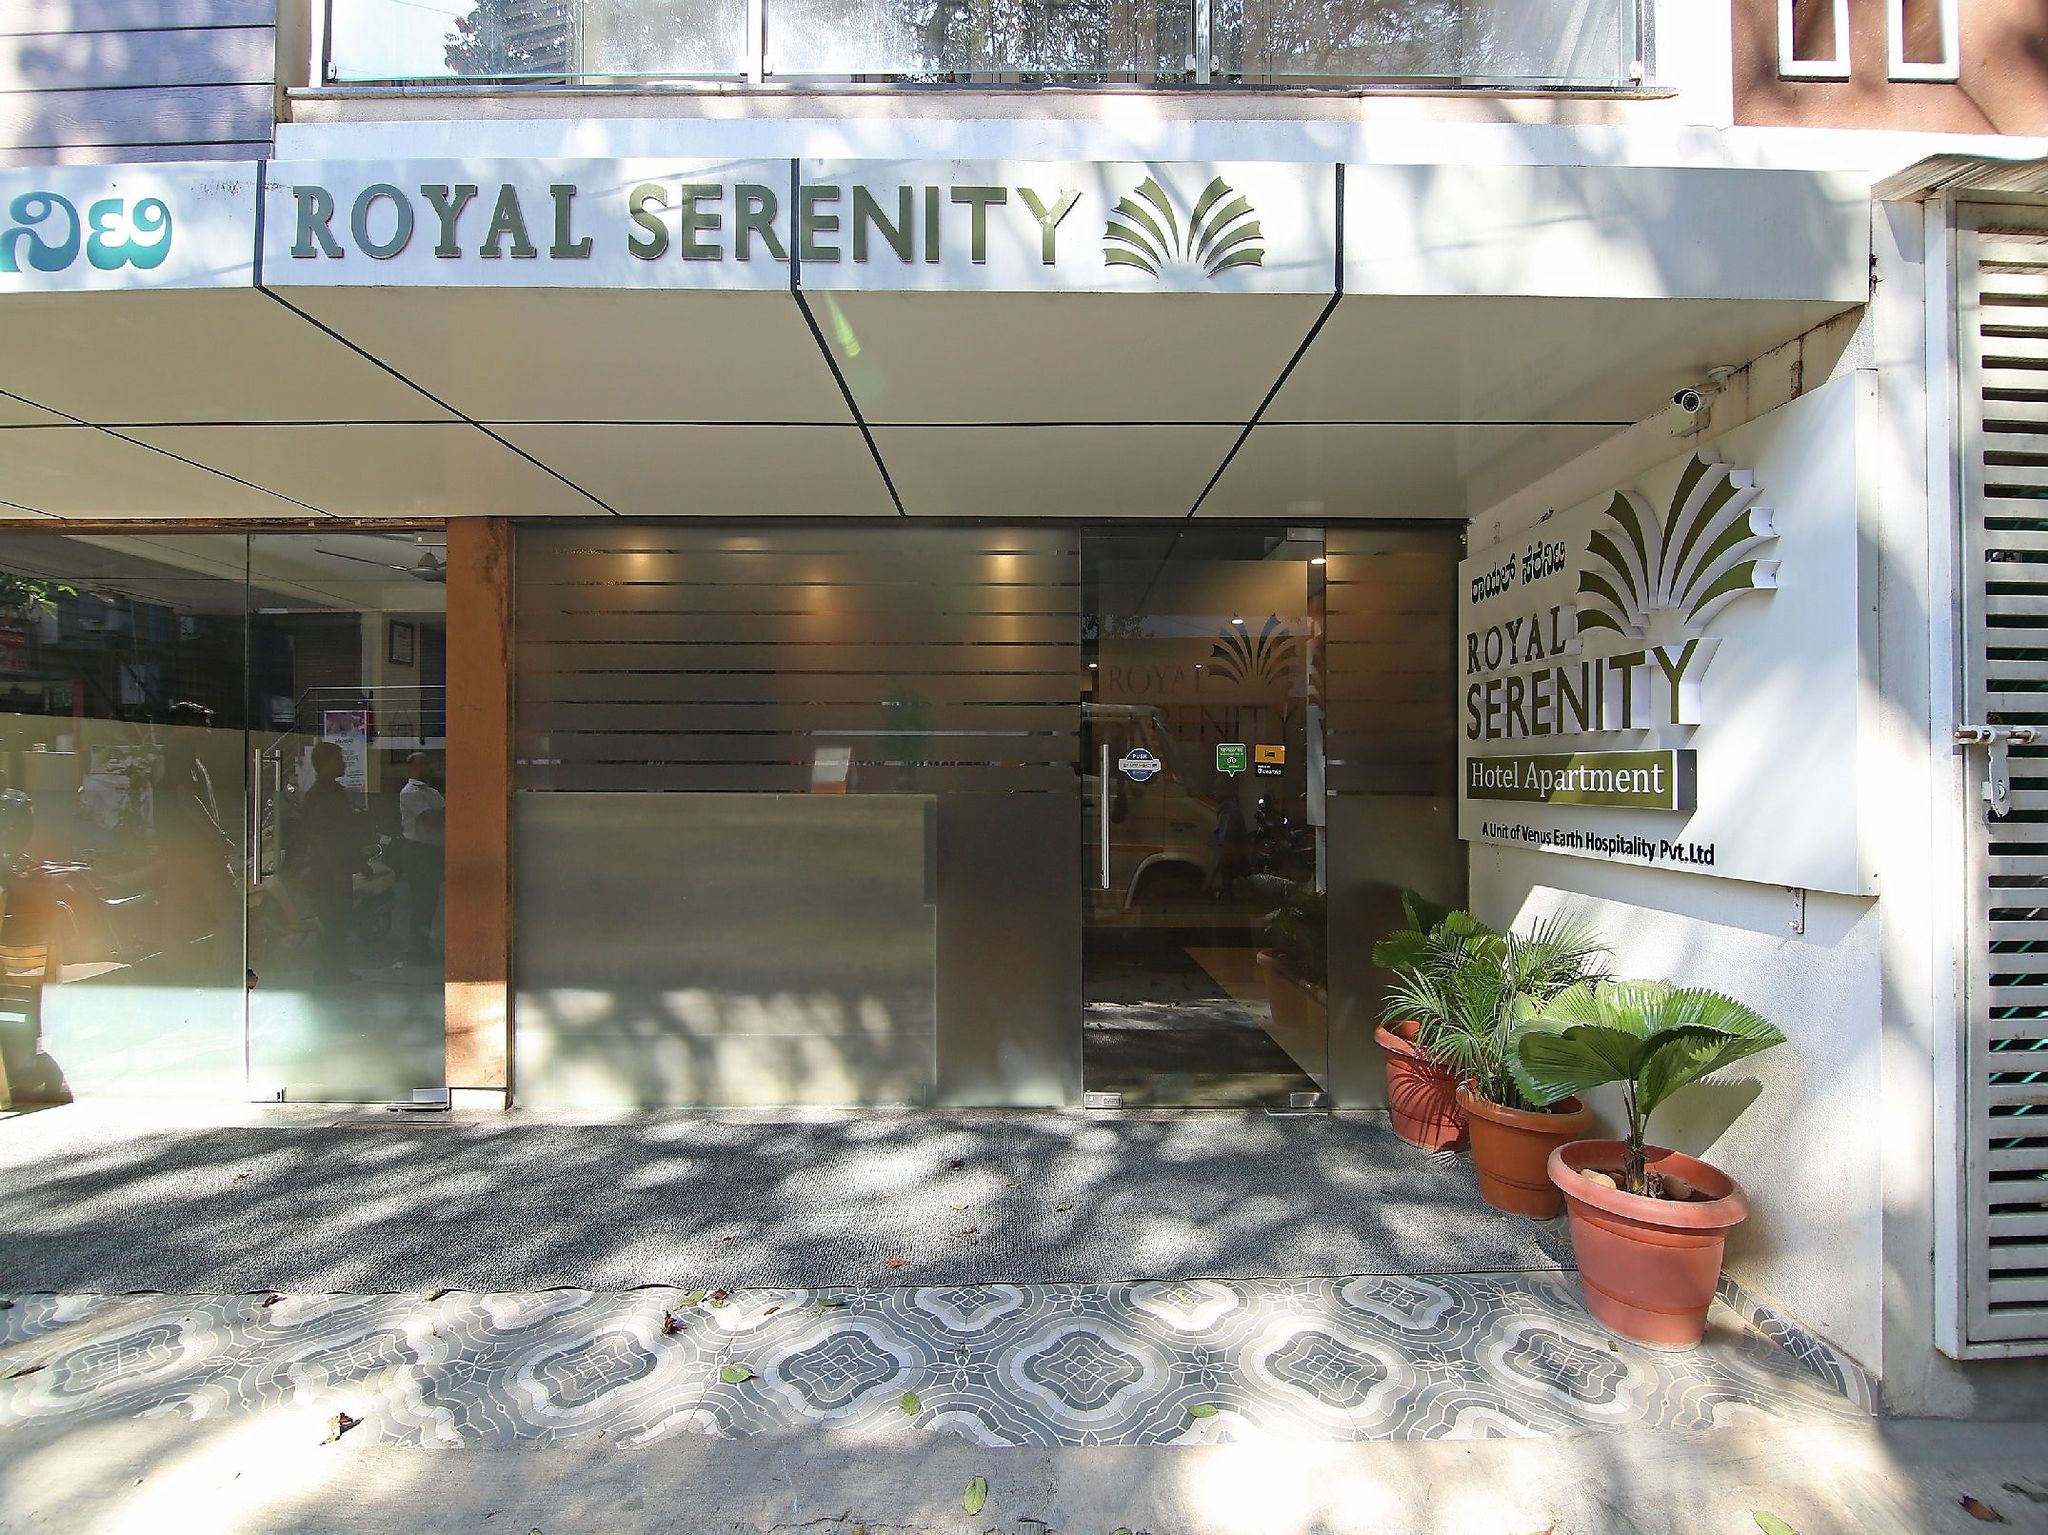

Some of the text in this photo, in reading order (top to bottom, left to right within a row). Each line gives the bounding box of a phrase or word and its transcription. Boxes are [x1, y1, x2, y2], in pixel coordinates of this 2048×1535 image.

[290, 182, 1084, 266] ROYAL SERENITY
[1471, 540, 1566, 604] ರಾಯಲ್ ಸೆರೆನಿಟಿ
[1466, 605, 1567, 675] ROYAL
[1108, 664, 1207, 696] ROYAL
[1466, 638, 1699, 740] SERENITY
[1471, 761, 1665, 798] Hotel Apartment
[1482, 822, 1715, 866] A Unit of Venus Earth Hospitality Pvt.Ltd
